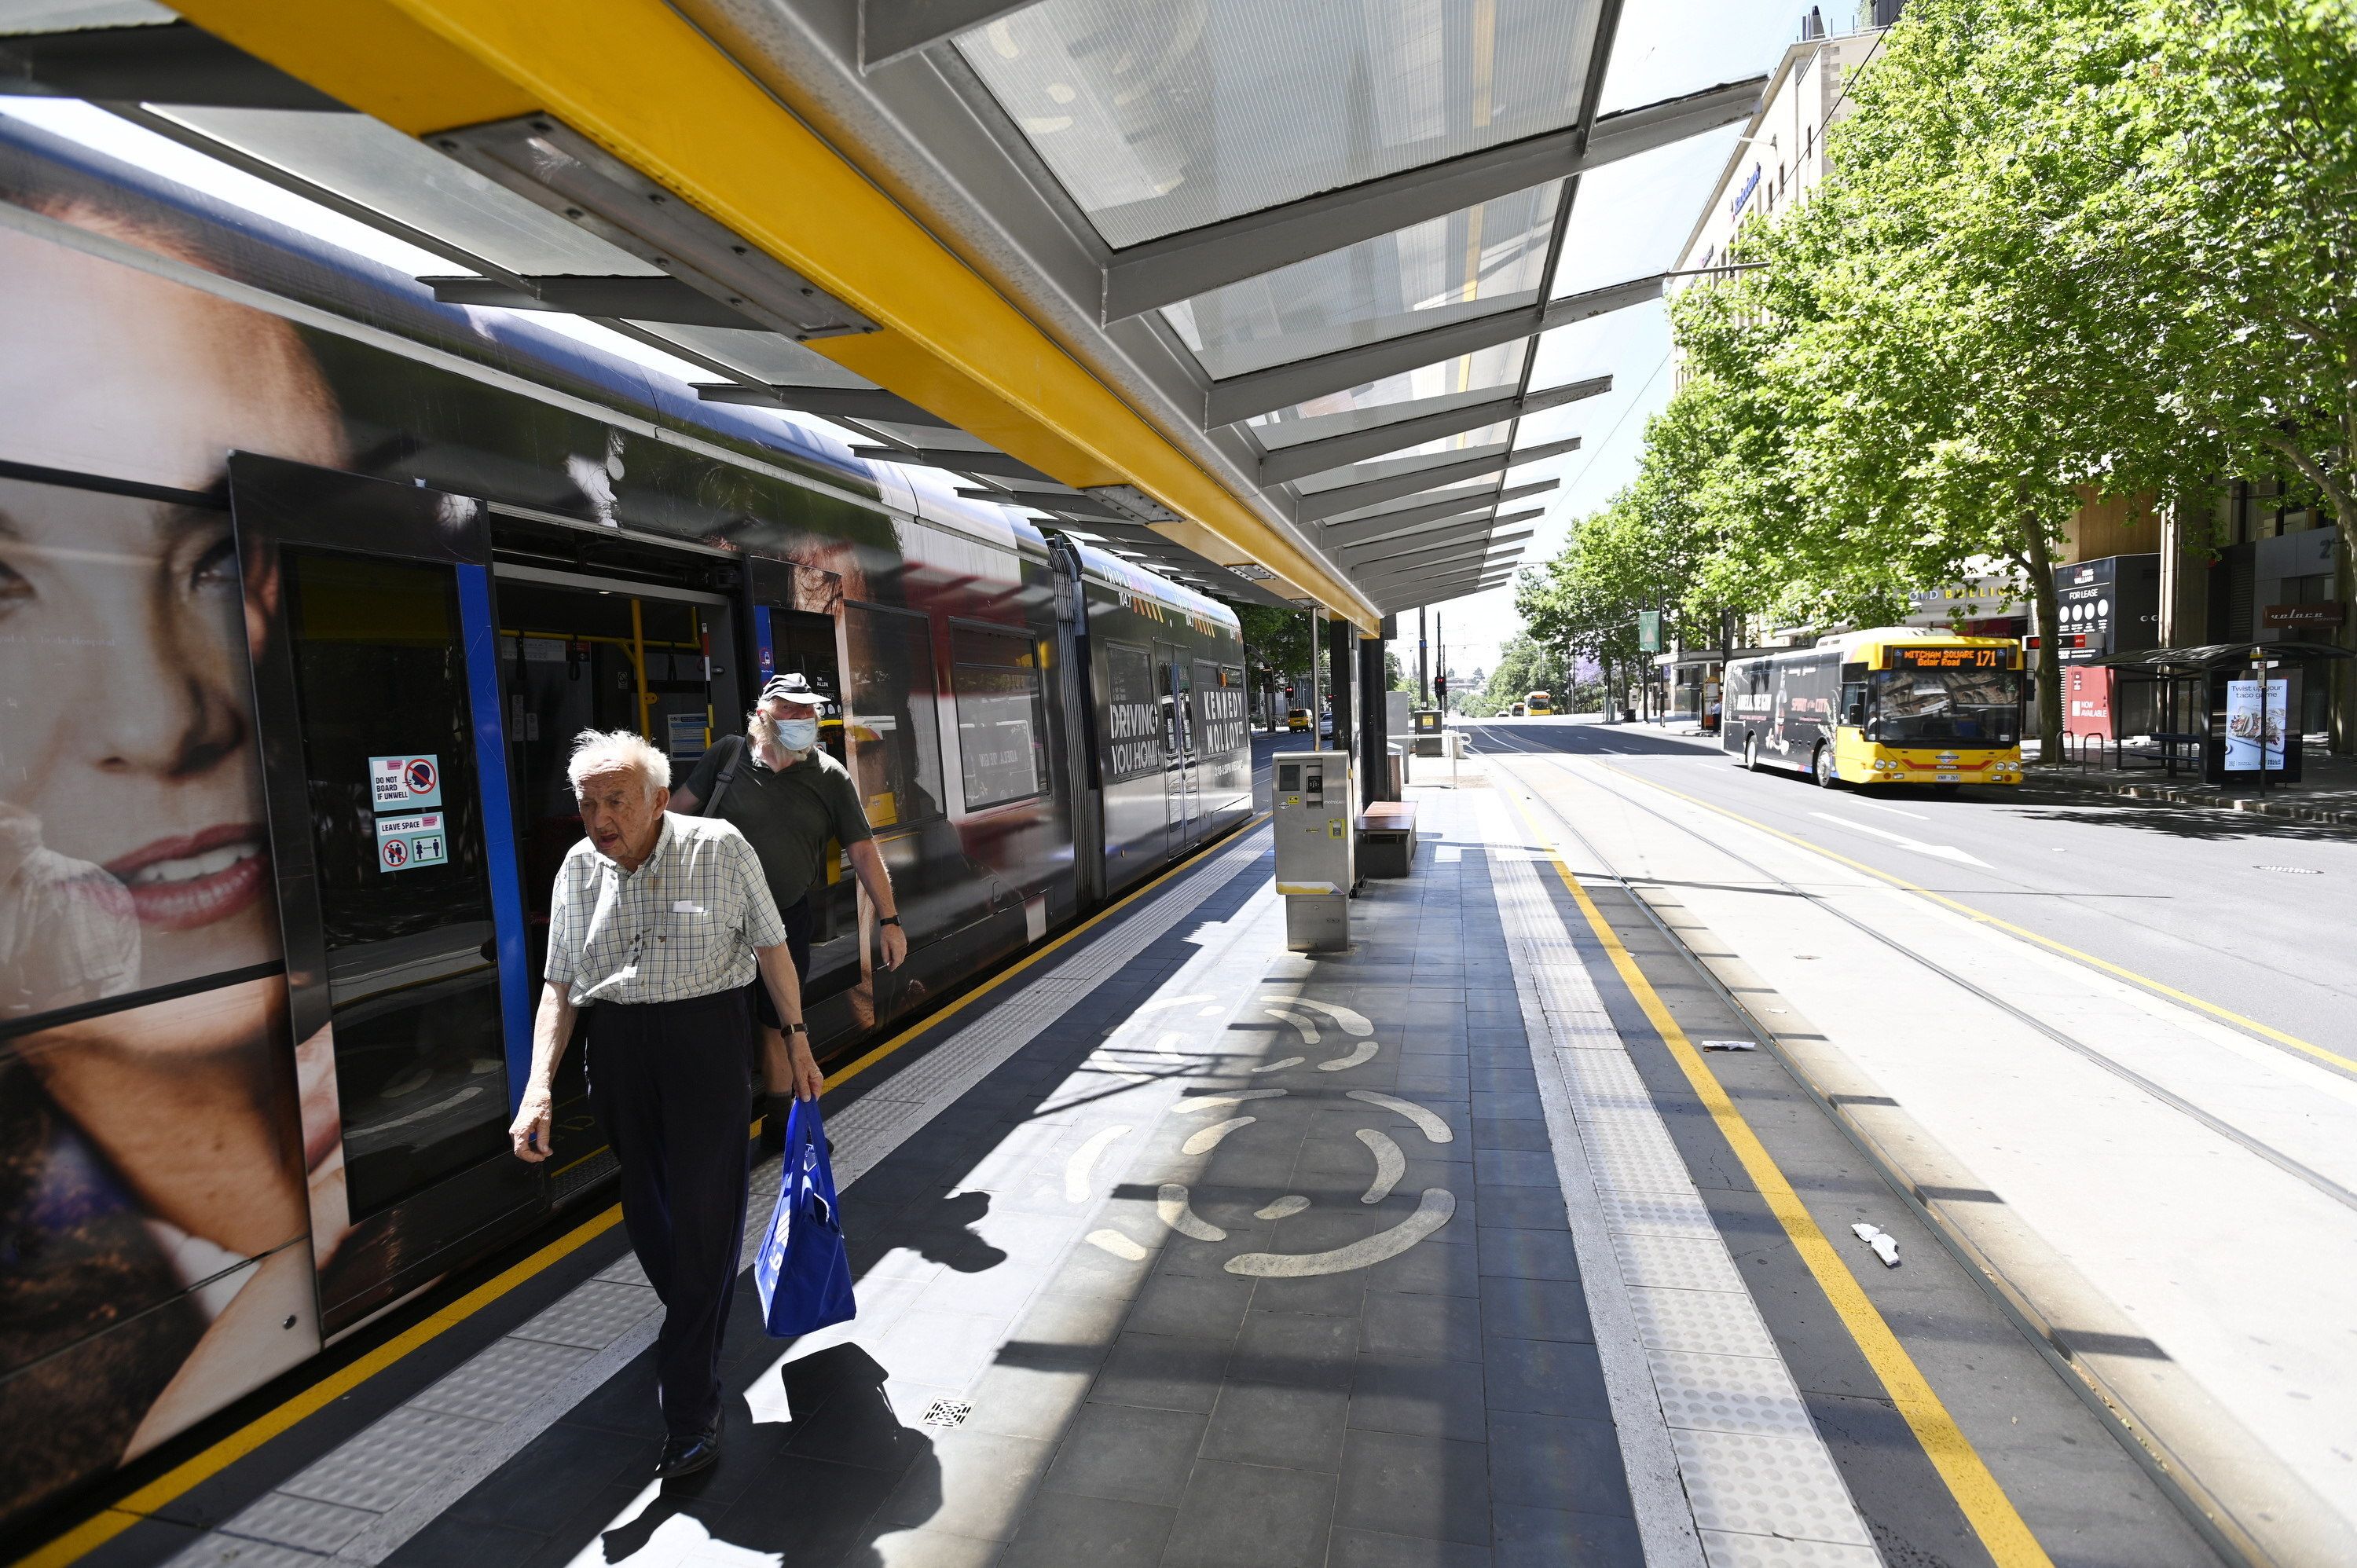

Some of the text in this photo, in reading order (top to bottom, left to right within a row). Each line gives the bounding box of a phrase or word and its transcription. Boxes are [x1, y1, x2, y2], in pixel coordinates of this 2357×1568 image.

[1100, 564, 1133, 589] TRIPLE
[1908, 590, 1938, 601] OLD
[2081, 588, 2098, 598] LEASE
[1904, 650, 1974, 659] MITCHAM SQUARE
[1976, 650, 1996, 666] 171
[1204, 691, 1242, 720] KENNEDY
[1110, 704, 1158, 738] DRIVING
[1207, 721, 1239, 754] MOLLOY
[1112, 746, 1132, 774] YOU
[382, 822, 401, 832] LEAVE
[402, 821, 420, 830] SPACE
